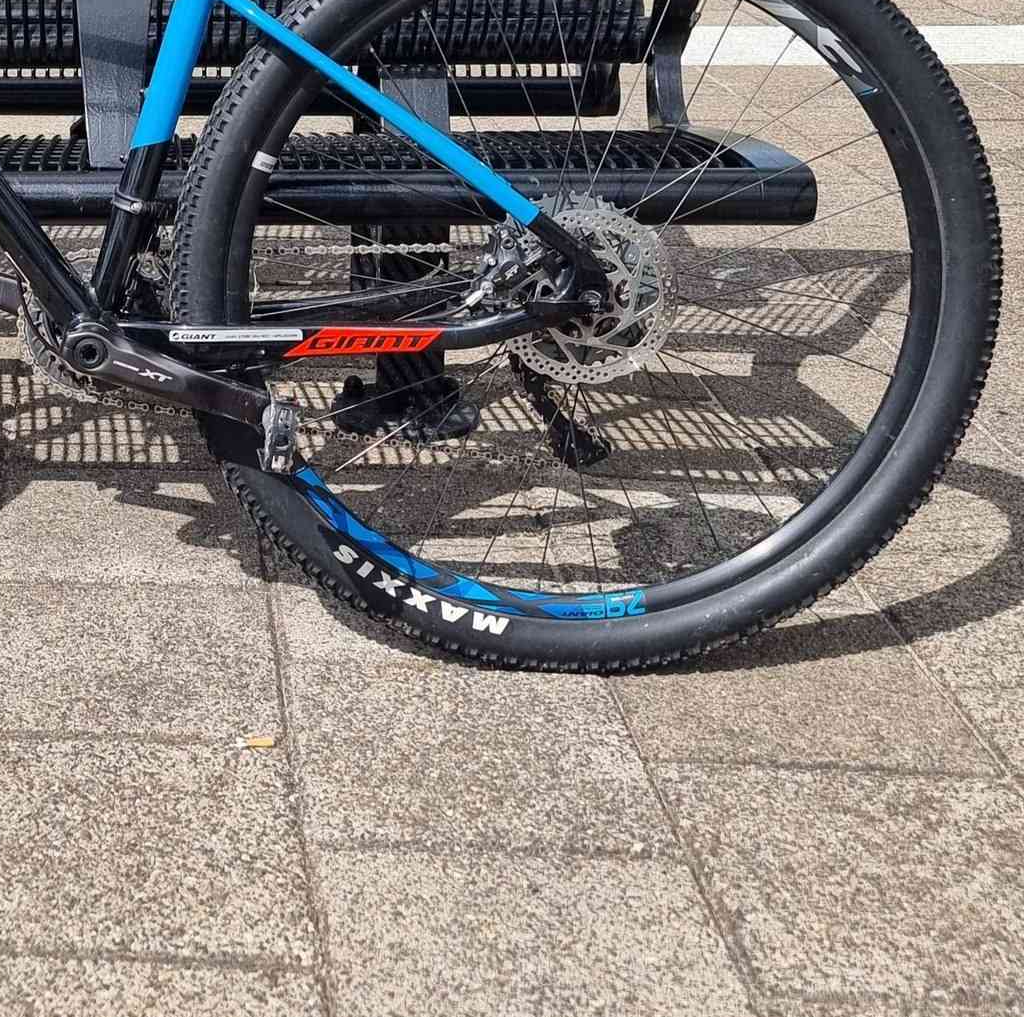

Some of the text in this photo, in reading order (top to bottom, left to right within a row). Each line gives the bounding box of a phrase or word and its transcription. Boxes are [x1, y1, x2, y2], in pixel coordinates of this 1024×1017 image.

[181, 333, 216, 341] GIANT
[308, 333, 431, 350] GIANT
[137, 368, 173, 382] XT
[333, 544, 512, 636] MAXXIS
[560, 606, 604, 619] GIANT
